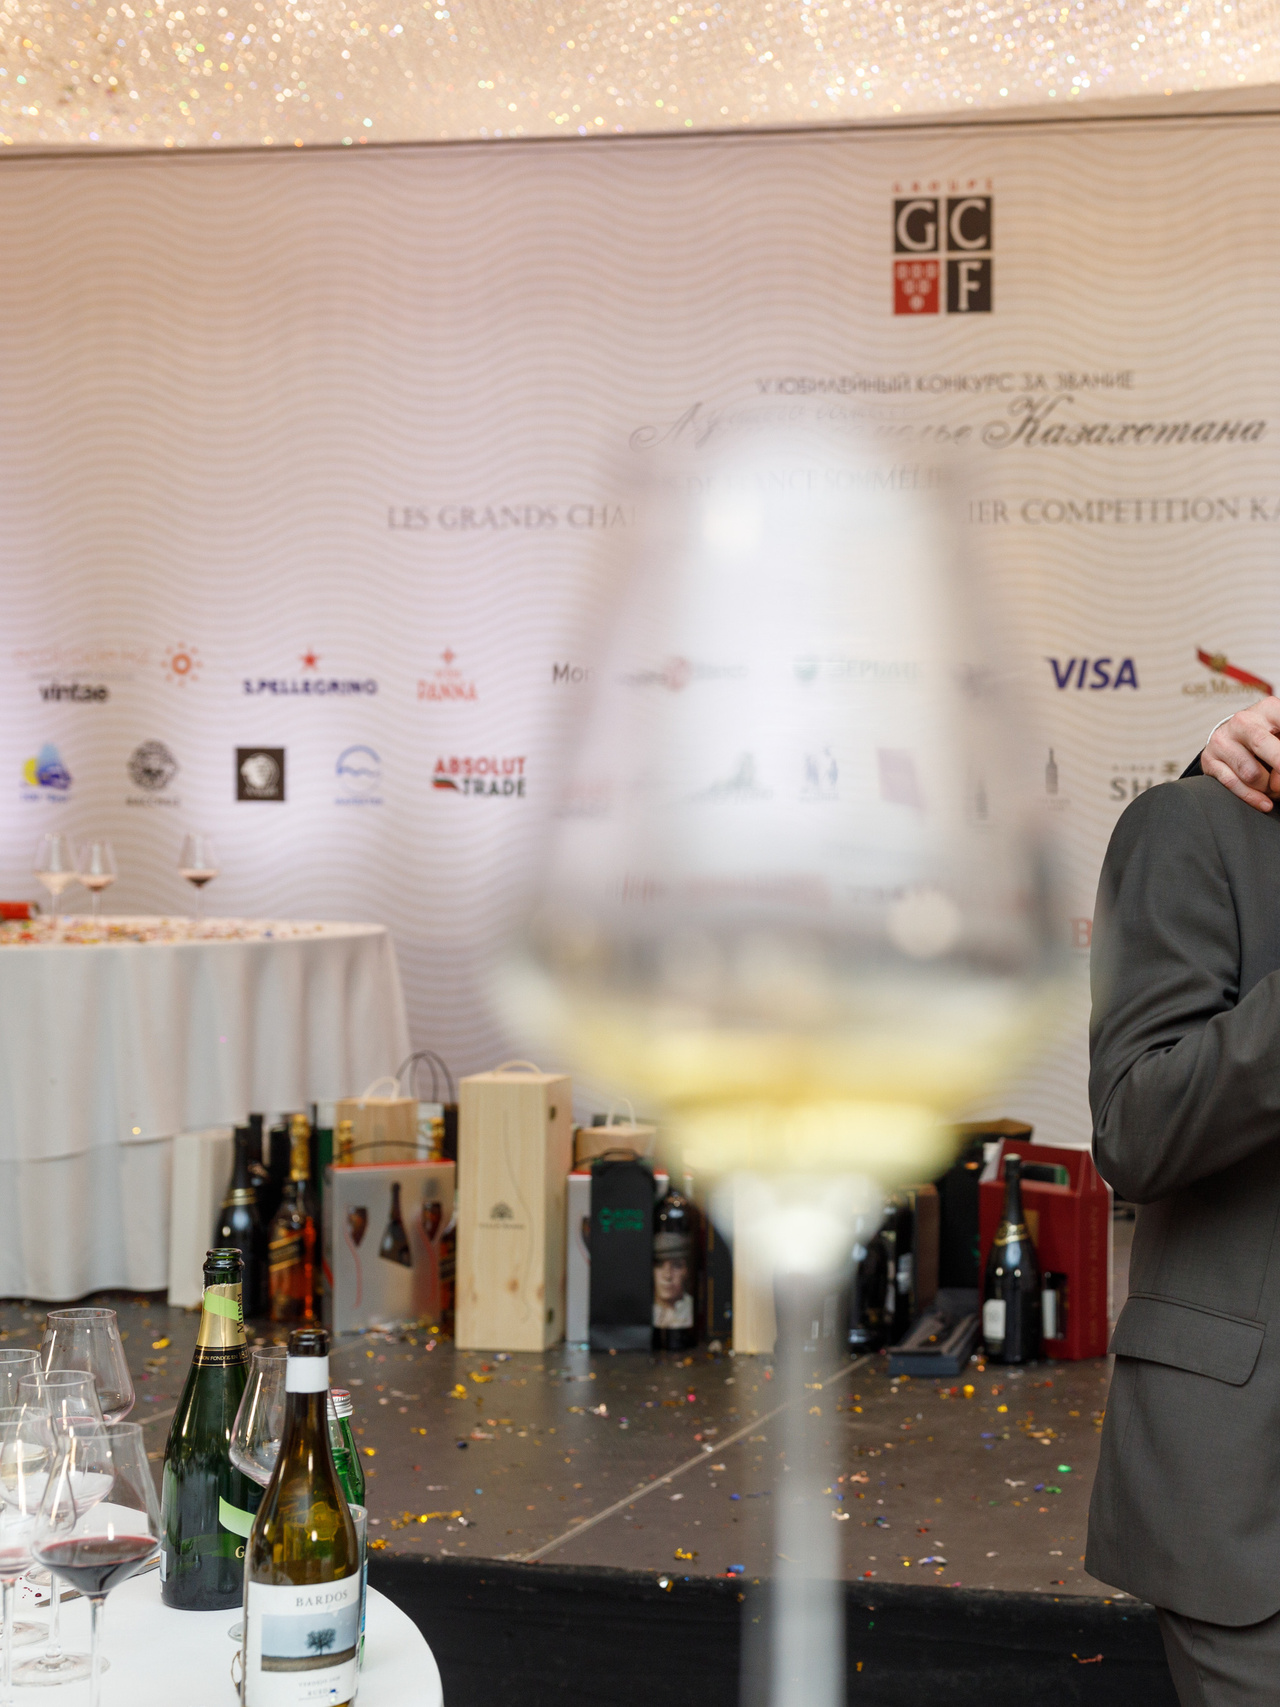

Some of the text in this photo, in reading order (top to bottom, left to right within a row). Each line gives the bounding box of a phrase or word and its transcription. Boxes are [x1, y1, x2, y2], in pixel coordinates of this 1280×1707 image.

[774, 373, 912, 396] ЮБИЛЕЙНЫЙ
[915, 374, 1014, 394] КОНКУРС
[1021, 373, 1047, 392] ЗА
[1054, 371, 1134, 392] ЗВАНИЕ
[981, 395, 1267, 449] Казахстана
[387, 505, 429, 531] LES
[438, 504, 559, 531] GRANDS
[567, 503, 638, 530] CHAI
[1020, 498, 1241, 525] COMPETITION
[1045, 658, 1138, 689] VISA
[243, 677, 378, 696] S.PELLEGRINO
[434, 756, 527, 775] ABSOLUT
[462, 778, 527, 797] TRADE
[296, 1589, 348, 1607] BARDOS
